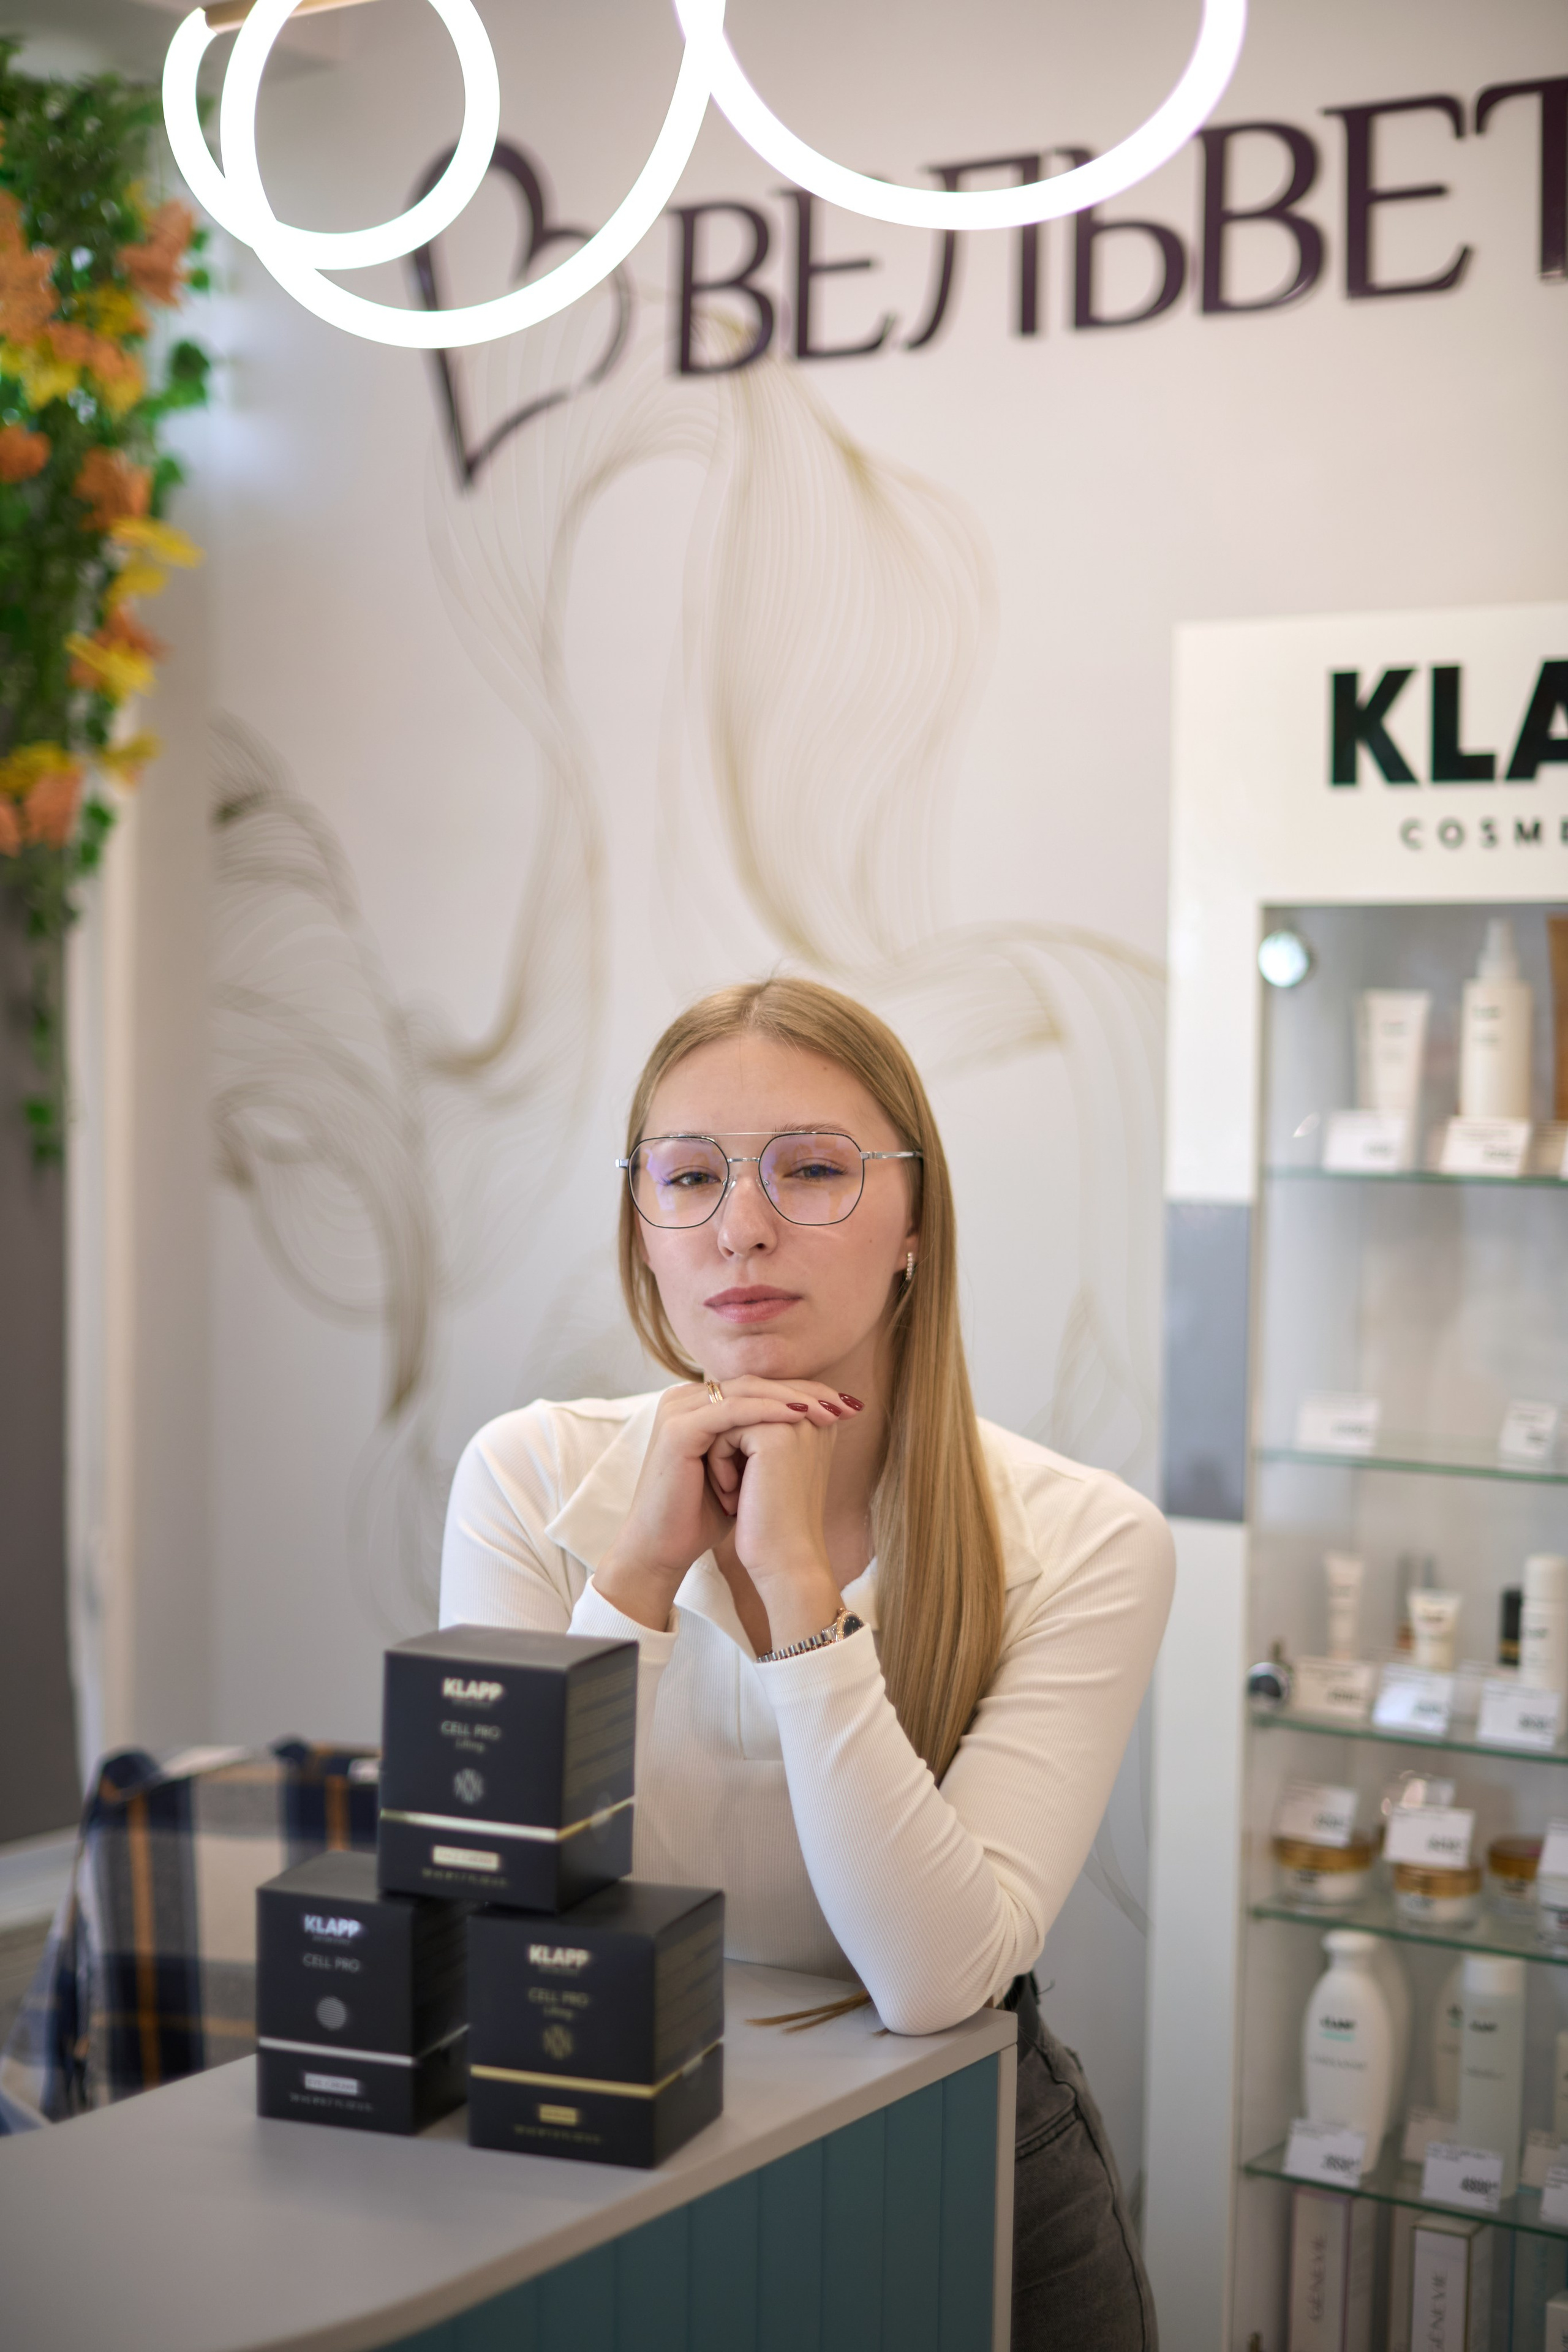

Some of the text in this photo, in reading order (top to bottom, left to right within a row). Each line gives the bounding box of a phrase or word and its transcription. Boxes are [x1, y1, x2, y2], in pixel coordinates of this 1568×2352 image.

[442, 1677, 504, 1702] KLAPP
[441, 1721, 501, 1741] CELL PRO
[304, 1914, 361, 1938] KLAPP
[303, 1953, 360, 1973] CELL PRO
[530, 1944, 590, 1968] KLAPP
